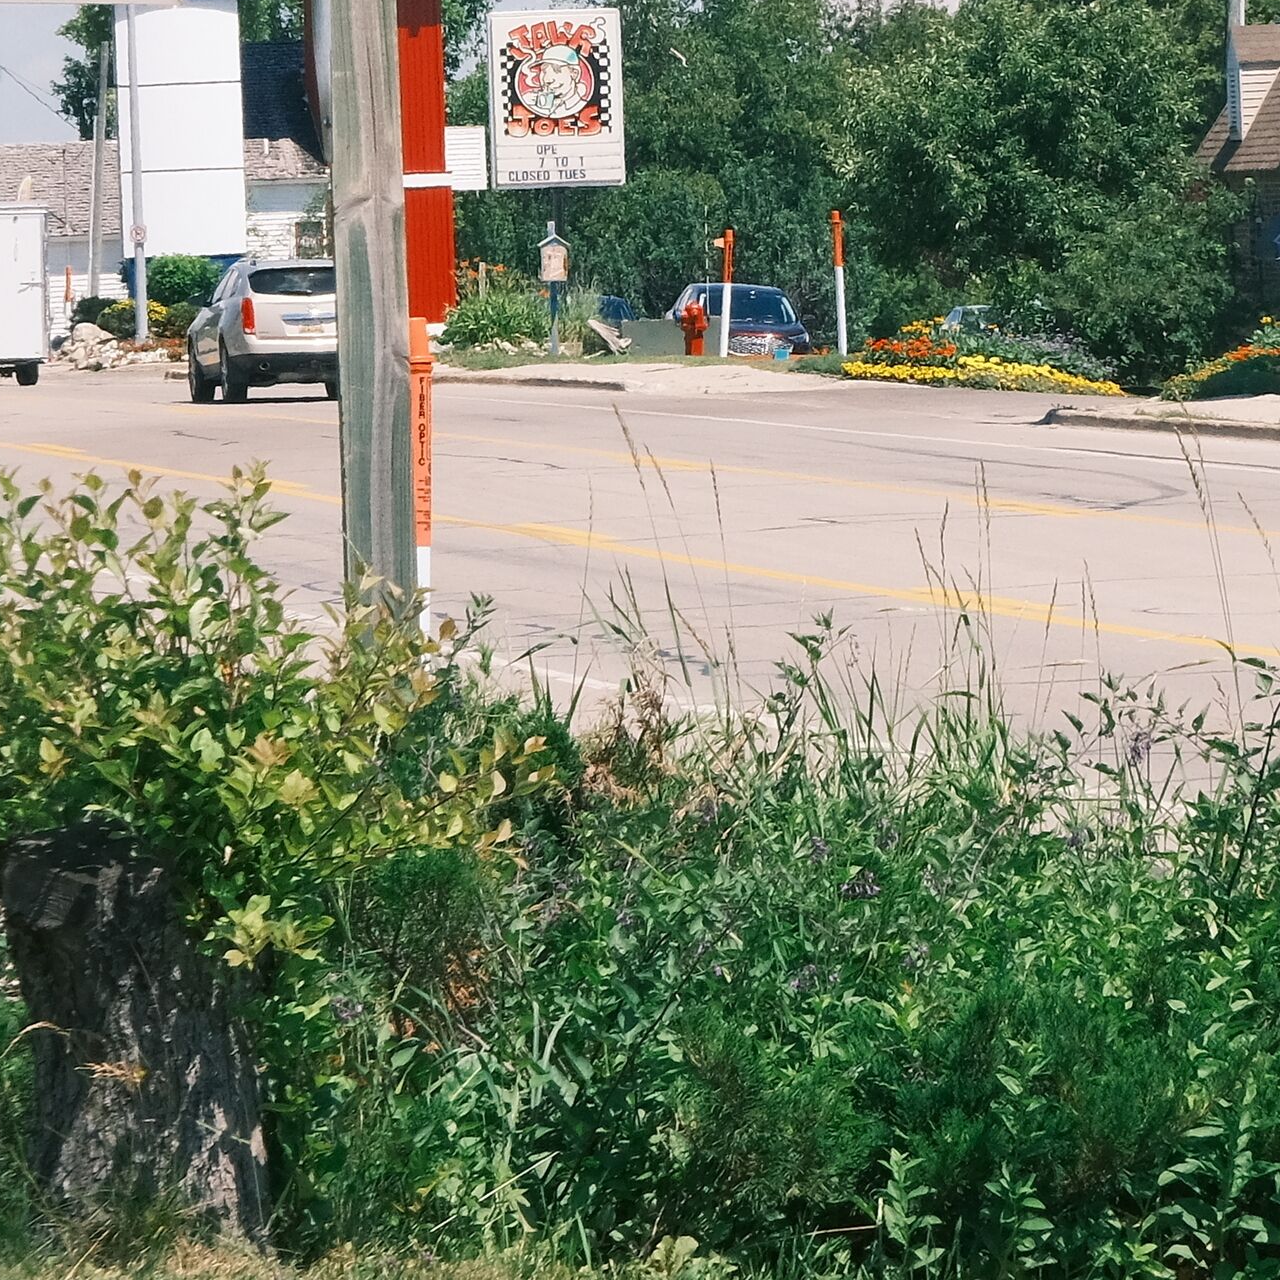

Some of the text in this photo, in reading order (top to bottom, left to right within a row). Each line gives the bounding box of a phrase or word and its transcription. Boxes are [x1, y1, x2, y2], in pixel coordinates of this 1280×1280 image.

[555, 156, 569, 167] TO
[508, 169, 586, 182] CLOSED TUES
